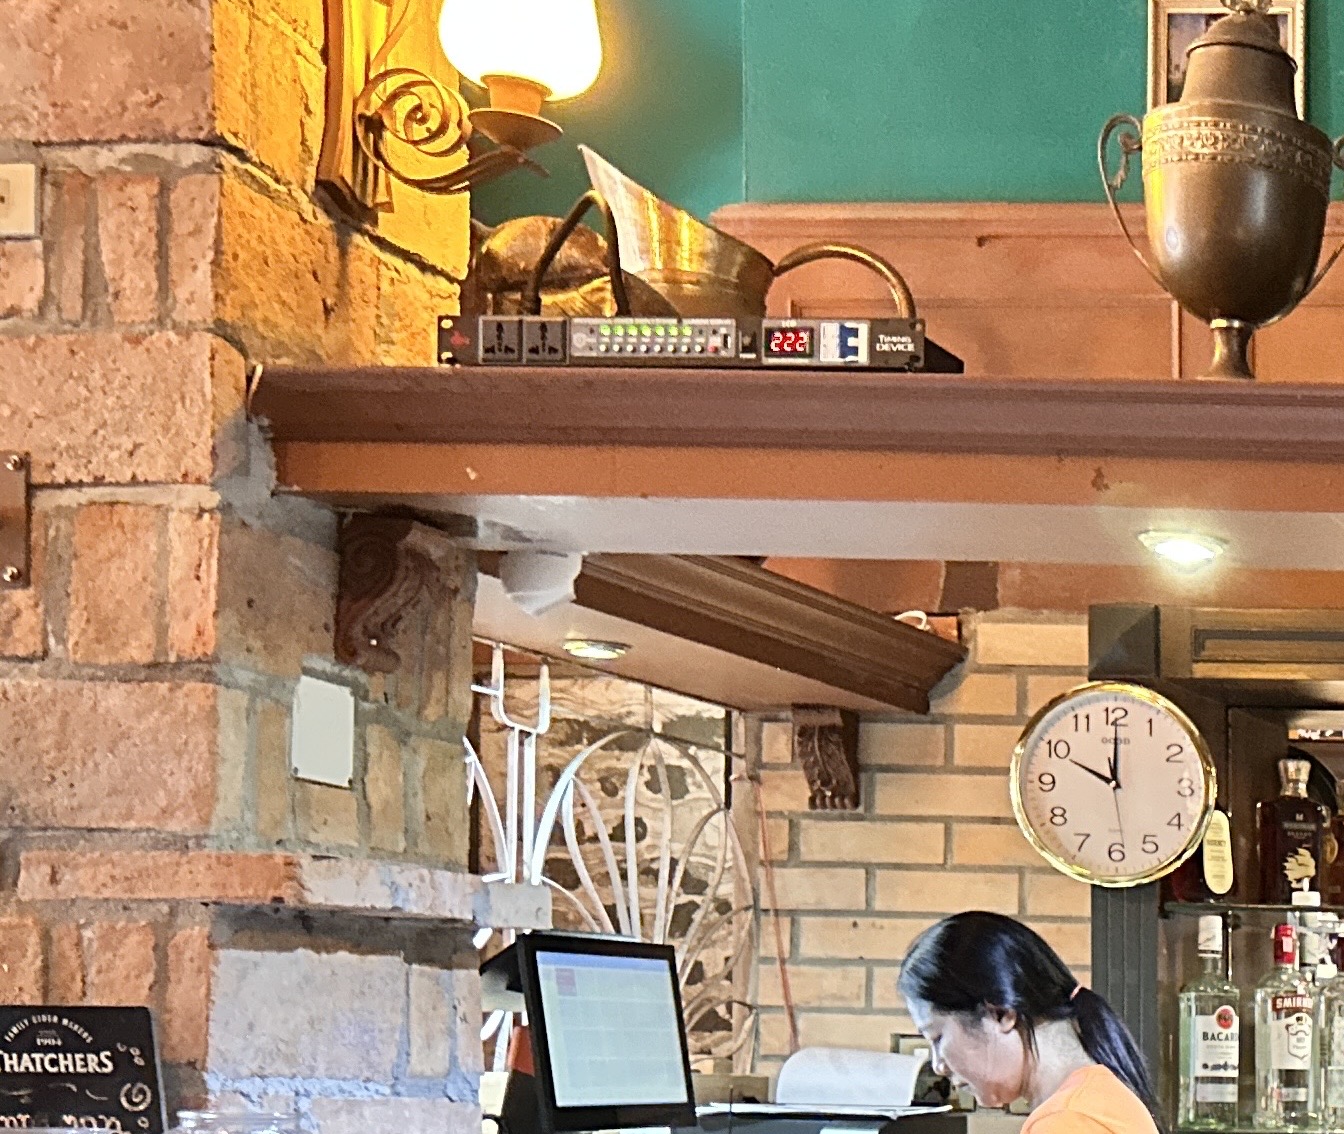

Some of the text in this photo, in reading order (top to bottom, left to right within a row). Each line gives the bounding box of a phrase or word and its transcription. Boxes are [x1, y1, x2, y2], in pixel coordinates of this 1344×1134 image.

[876, 342, 915, 352] DEVICE
[1073, 713, 1090, 733] 11
[1104, 706, 1129, 727] 12
[1147, 717, 1154, 738] 1
[1046, 738, 1071, 760] 10
[1165, 743, 1184, 764] 2
[1037, 772, 1056, 792] 9
[1176, 777, 1195, 798] 3
[1050, 806, 1068, 827] 8
[1166, 812, 1184, 831] 4
[1073, 832, 1091, 853] 7
[1108, 842, 1125, 863] 6
[1141, 834, 1159, 854] 5
